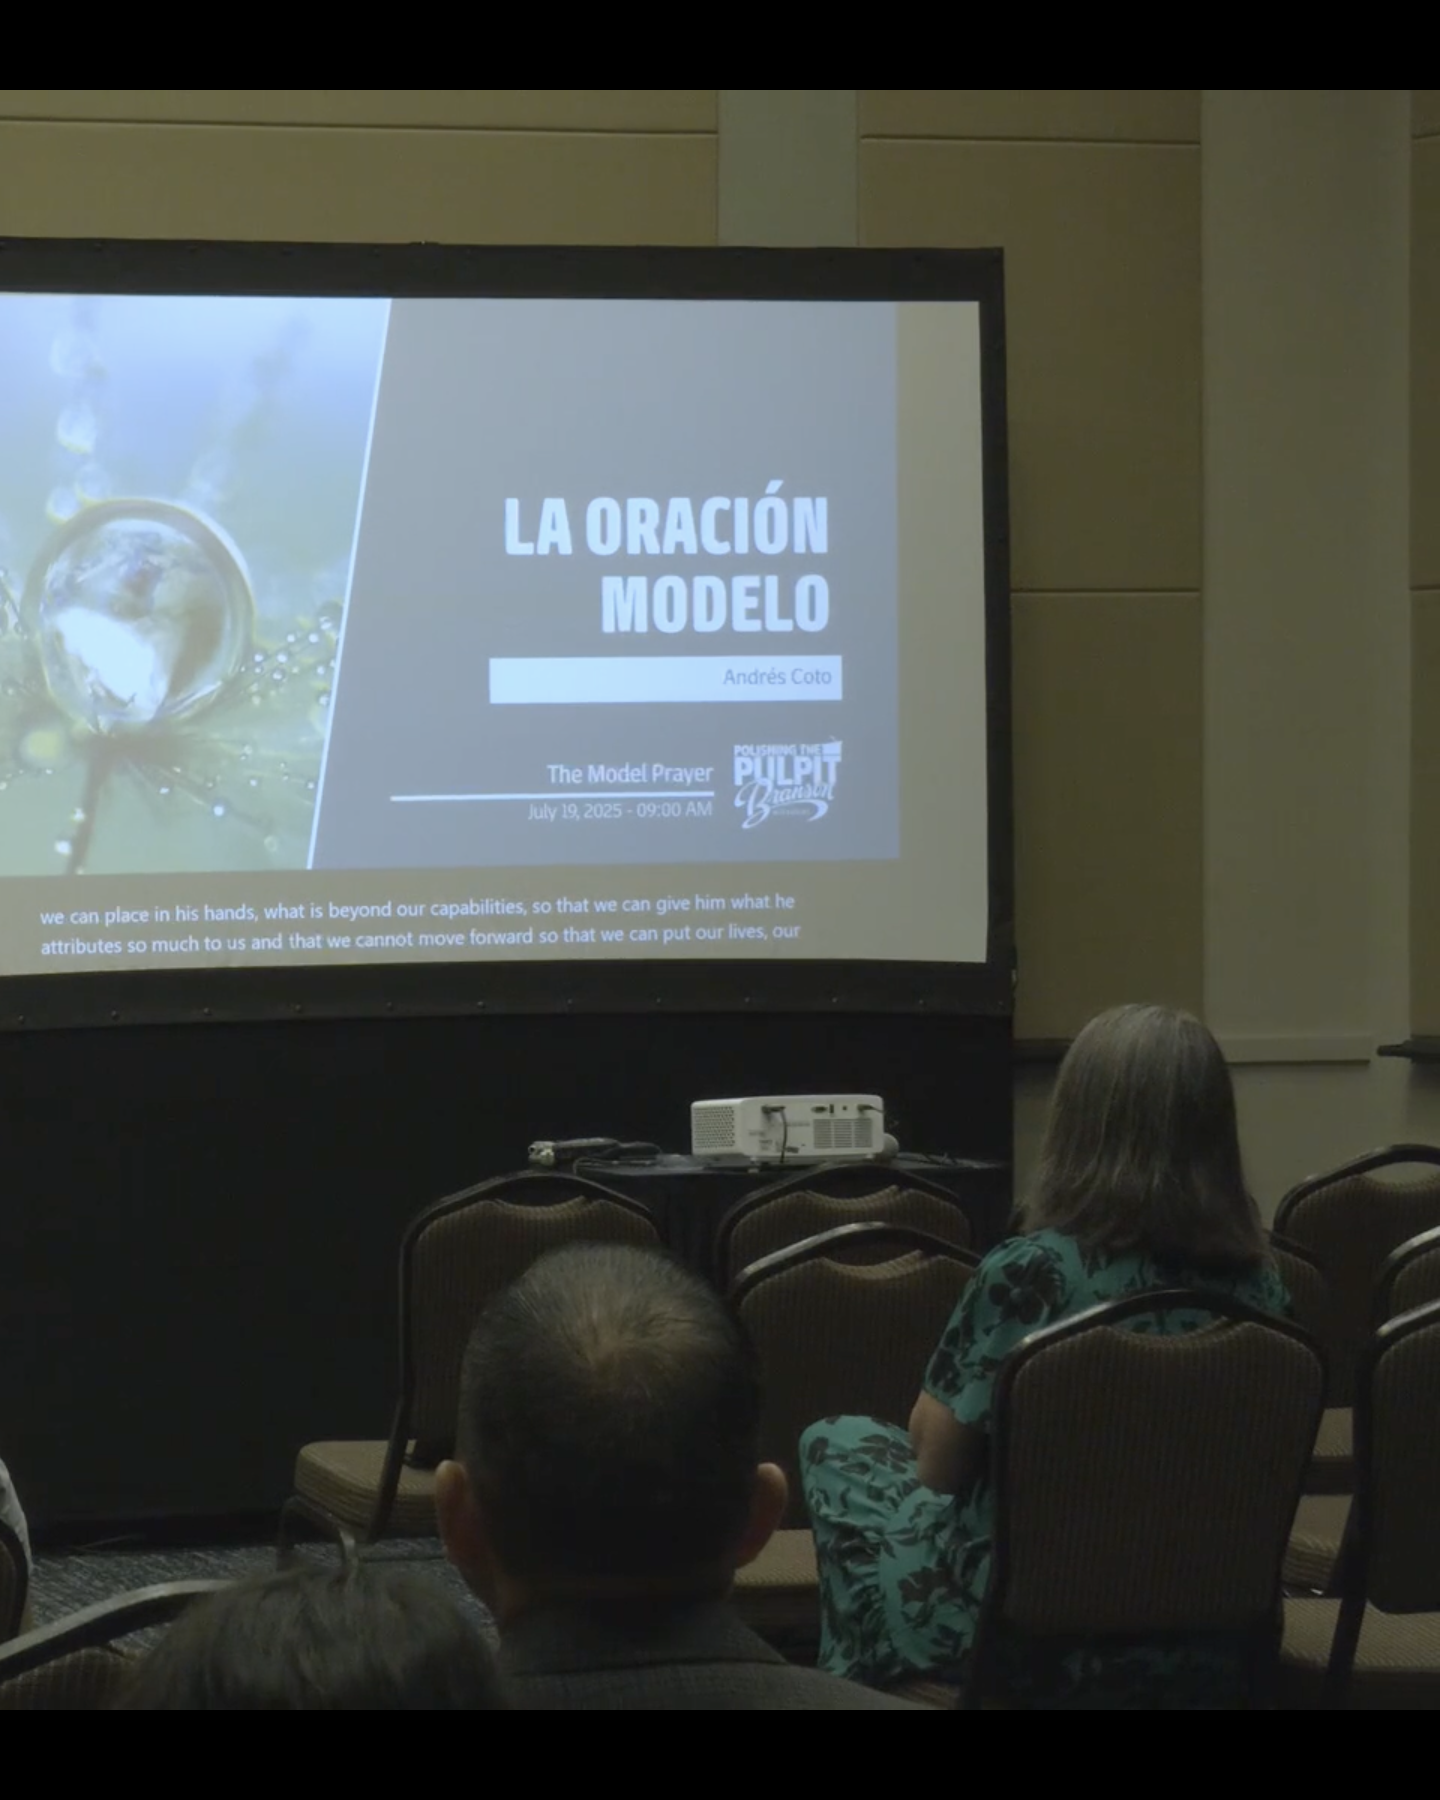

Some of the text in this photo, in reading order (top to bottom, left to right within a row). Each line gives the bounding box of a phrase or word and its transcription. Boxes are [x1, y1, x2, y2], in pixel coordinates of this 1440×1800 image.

[504, 479, 829, 556] LA ORACIÓN
[601, 574, 830, 634] MODELO
[723, 668, 832, 686] Andrés Coto
[548, 763, 714, 786] The Model Prayer
[734, 753, 841, 787] PULPIT
[528, 801, 557, 822] July
[562, 802, 581, 820] 19,
[585, 801, 623, 818] 2025
[636, 801, 682, 818] 09:00
[686, 800, 713, 816] AM
[40, 893, 794, 927] we can place in his hands, what is beyond our capabilities, so that we can give him what he
[41, 923, 800, 954] attributes so much to us and that we cannot move forward so that we can put our lives, our
